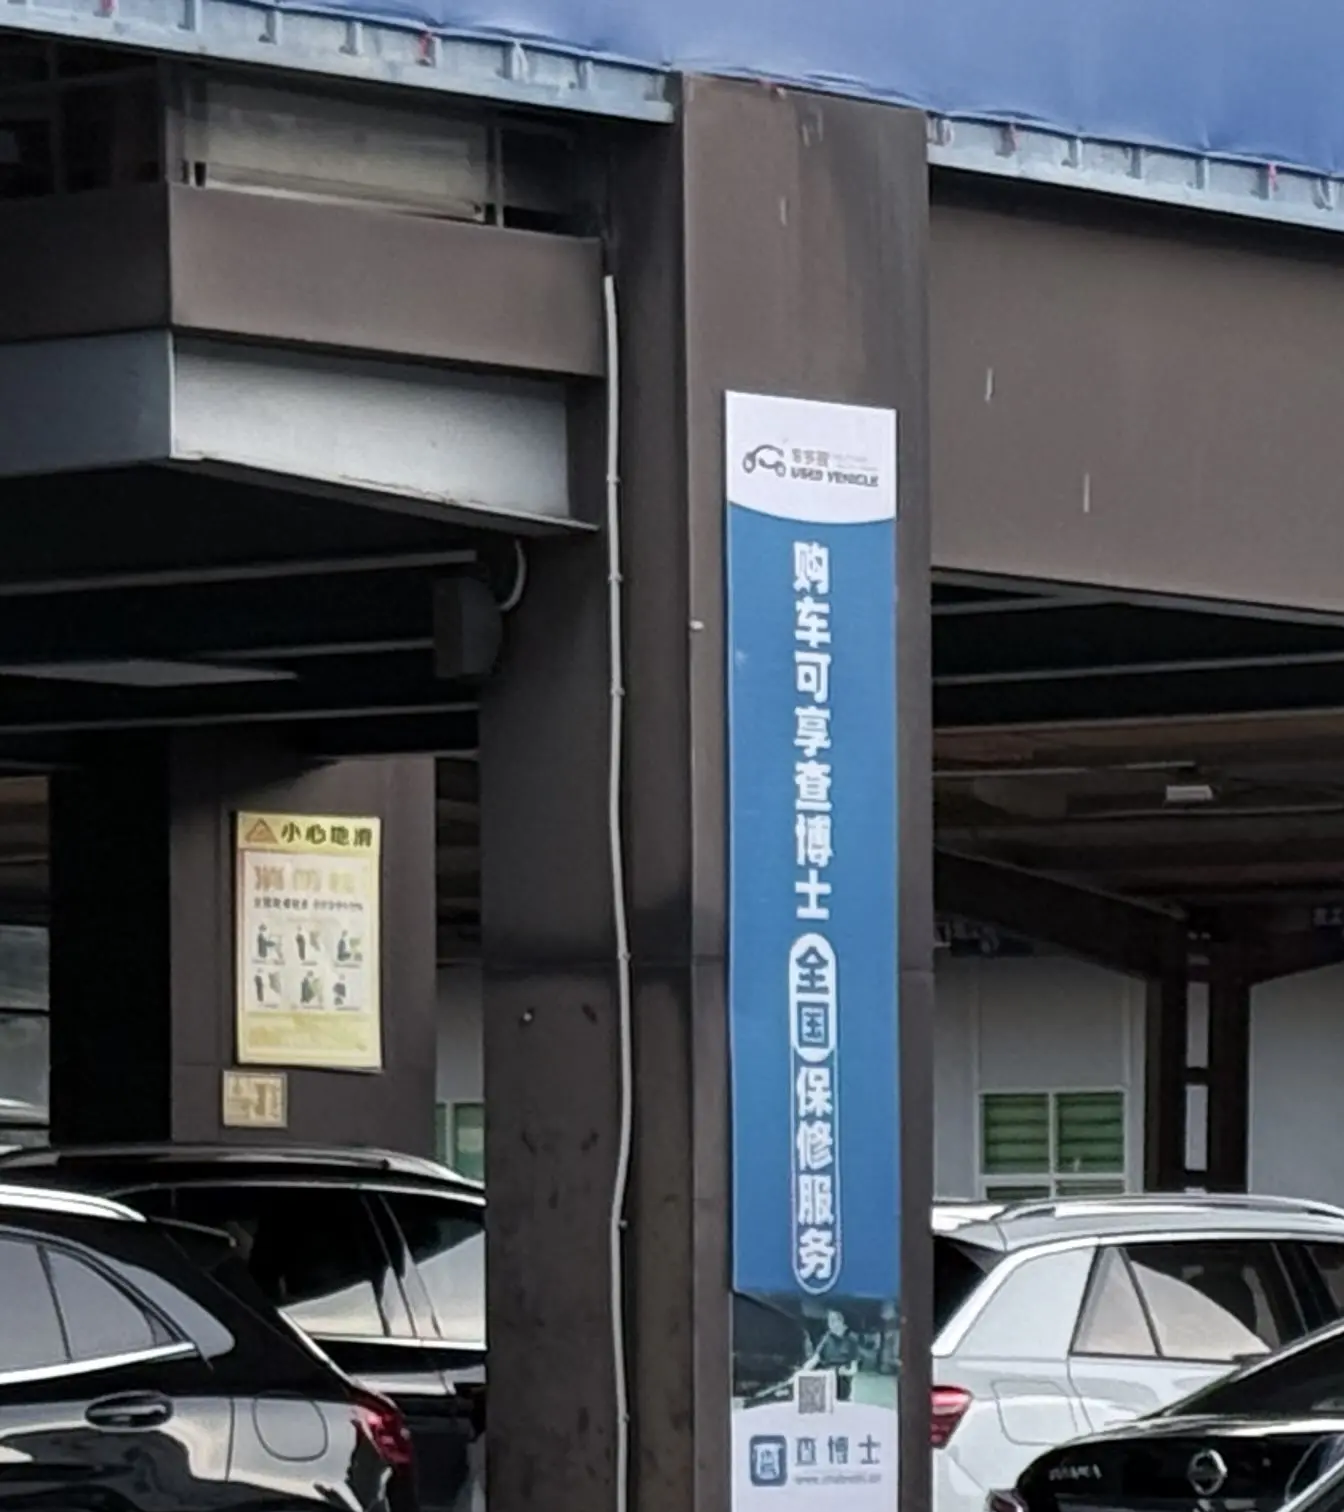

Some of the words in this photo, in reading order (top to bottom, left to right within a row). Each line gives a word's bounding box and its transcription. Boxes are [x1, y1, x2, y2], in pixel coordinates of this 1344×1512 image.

[281, 821, 373, 848] 小心地滑
[793, 541, 833, 920] 购车可享查博士
[795, 945, 836, 1282] 全国保修服务
